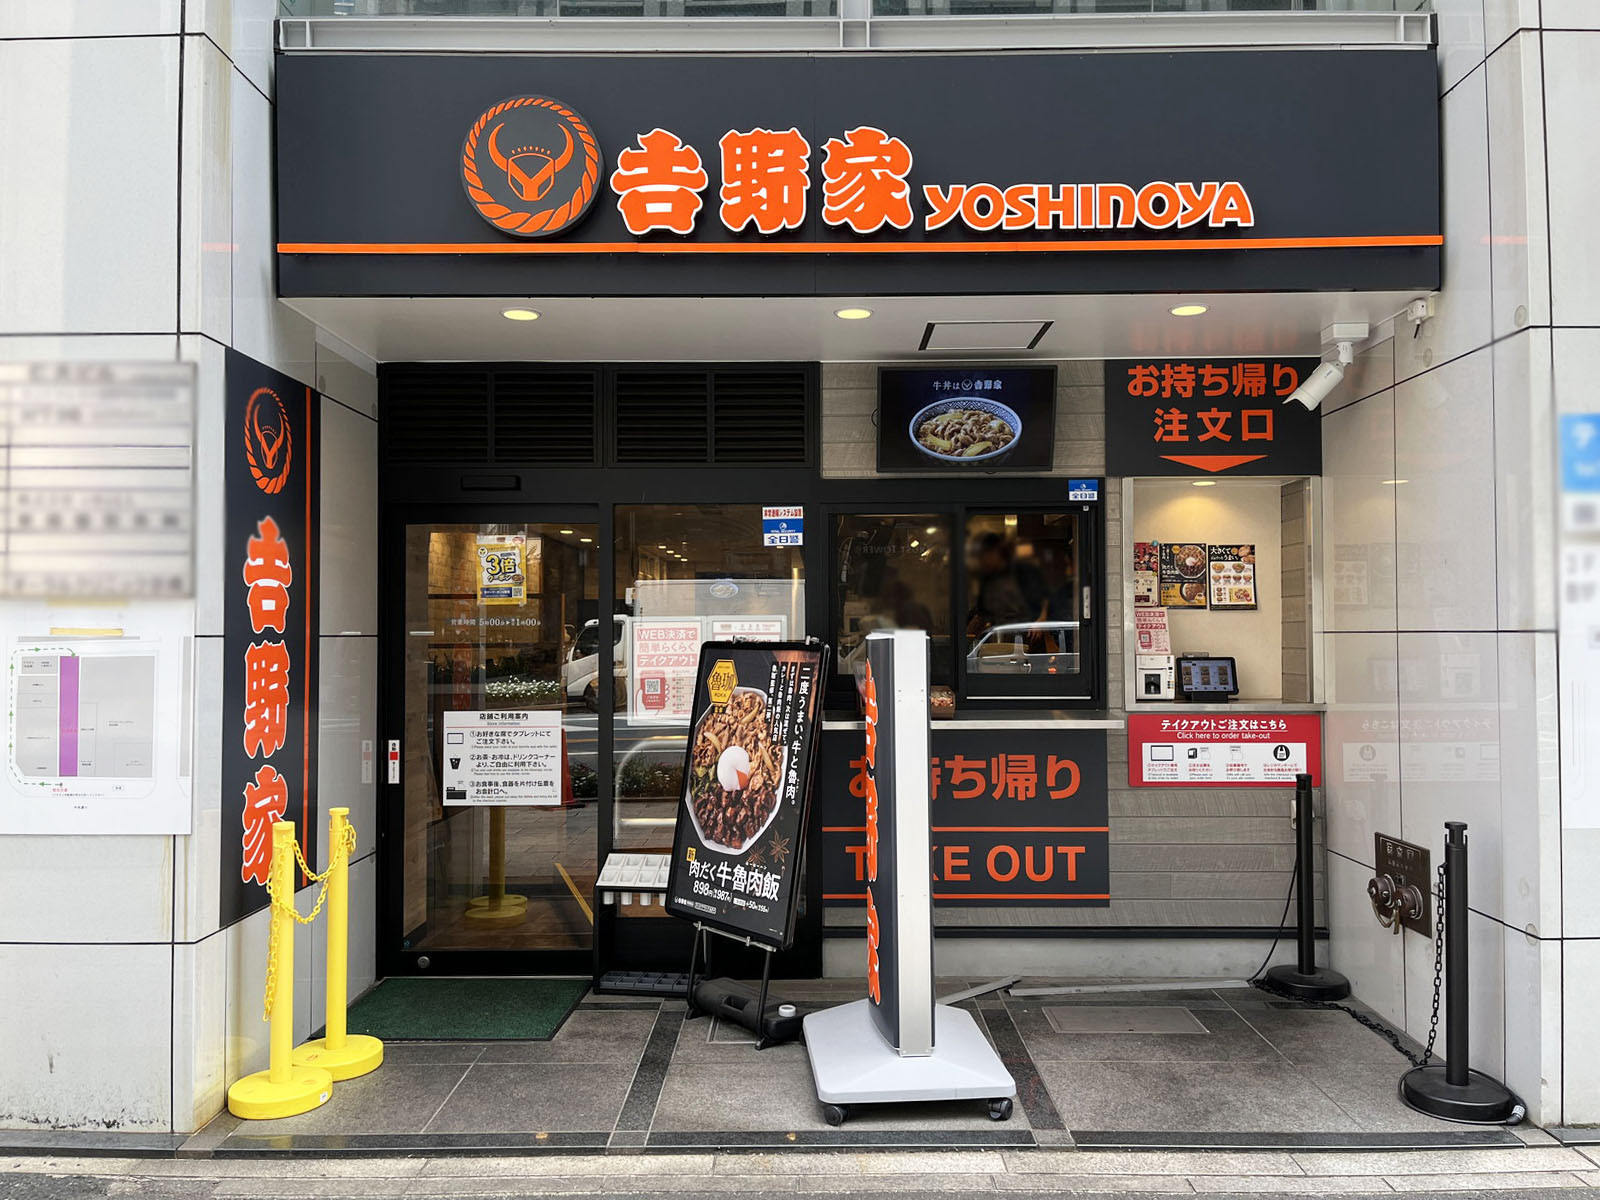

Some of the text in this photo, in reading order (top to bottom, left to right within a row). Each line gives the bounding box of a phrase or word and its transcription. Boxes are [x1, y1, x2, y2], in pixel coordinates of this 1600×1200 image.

[610, 126, 913, 235] 吉野家
[924, 180, 1255, 231] YOSHINOYA
[1127, 363, 1299, 398] お持ち帰り
[1153, 407, 1275, 442] 注文口
[486, 554, 517, 576] 3倍
[639, 629, 696, 640] WEB決済で
[639, 642, 695, 653] 簡単らくらく
[640, 656, 696, 666] テイクアウト
[480, 712, 528, 720] 店舗ご利用案内
[1161, 719, 1288, 730] テイクアウトご注文はこちら
[986, 845, 1086, 882] OUT
[688, 859, 781, 902] 肉だく牛魯肉飯
